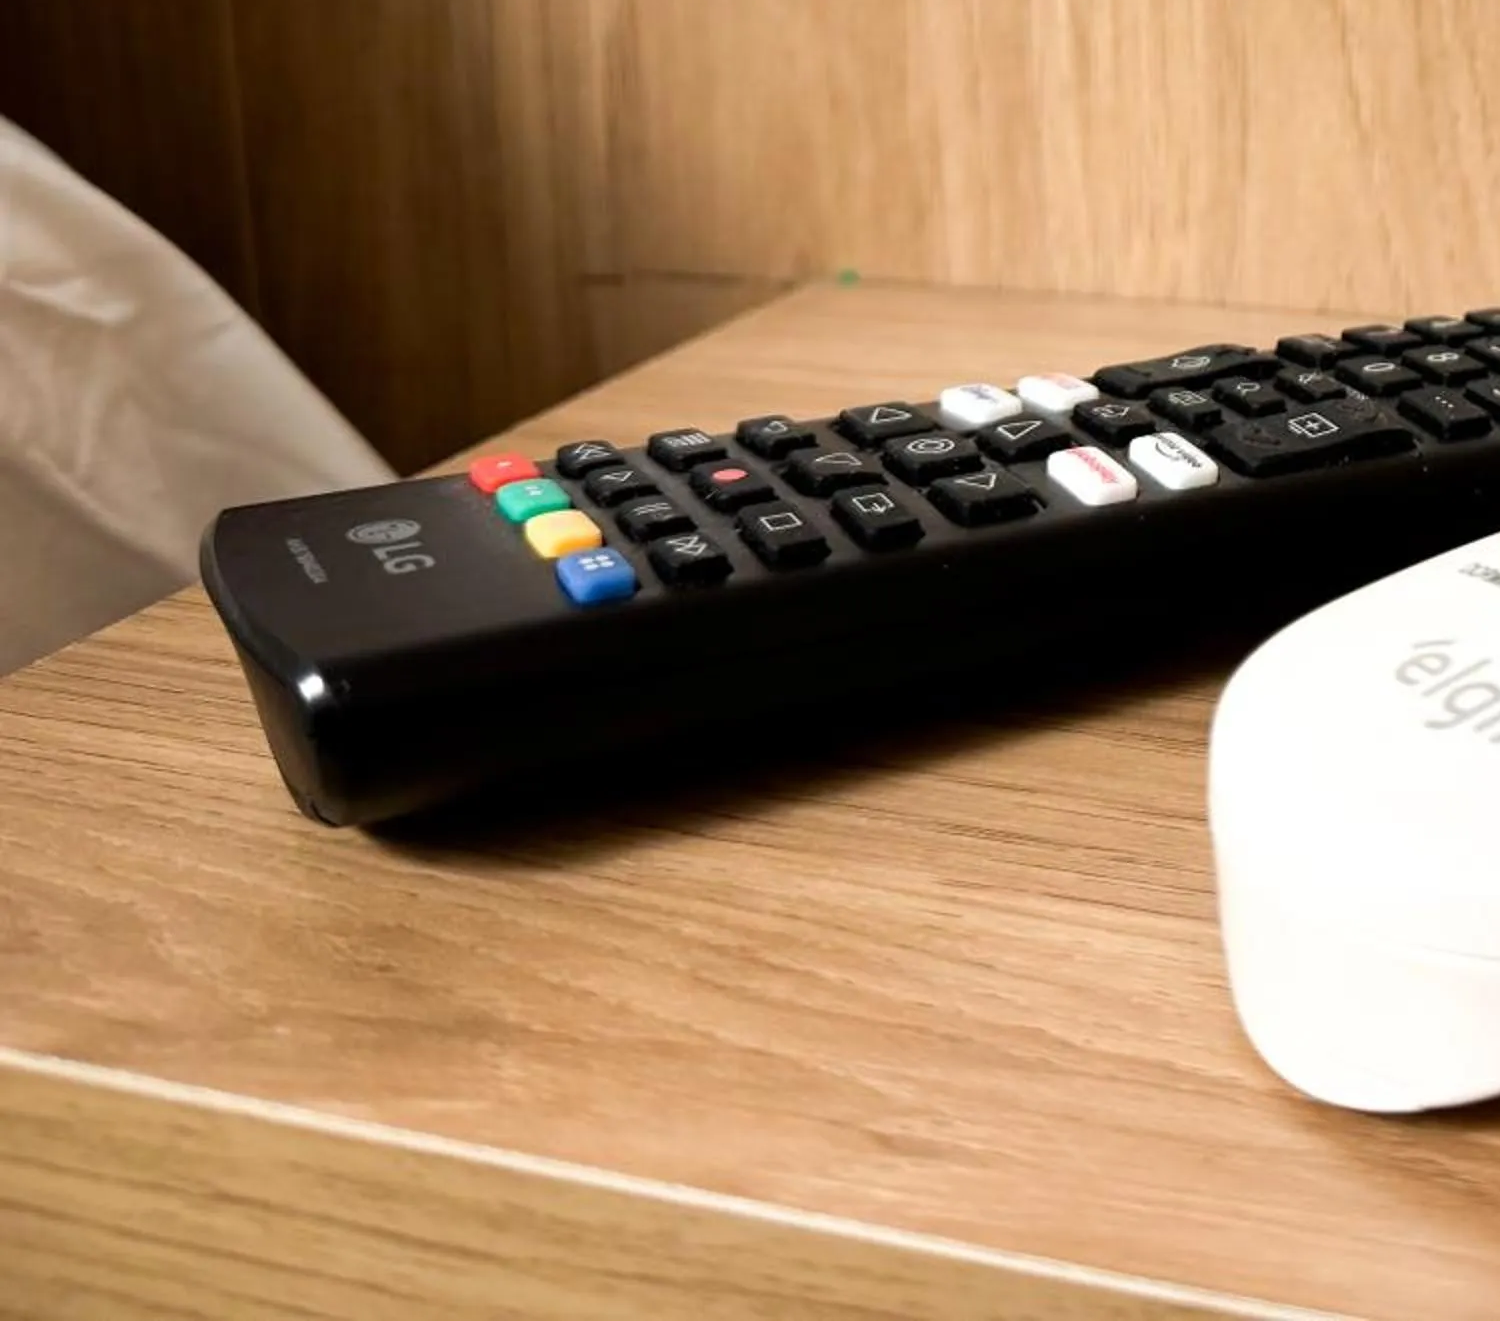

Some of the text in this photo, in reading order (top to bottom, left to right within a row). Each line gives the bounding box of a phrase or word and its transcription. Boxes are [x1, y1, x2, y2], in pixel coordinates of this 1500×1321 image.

[1426, 351, 1459, 363] 8
[1362, 362, 1396, 373] 0
[372, 541, 437, 575] LG
